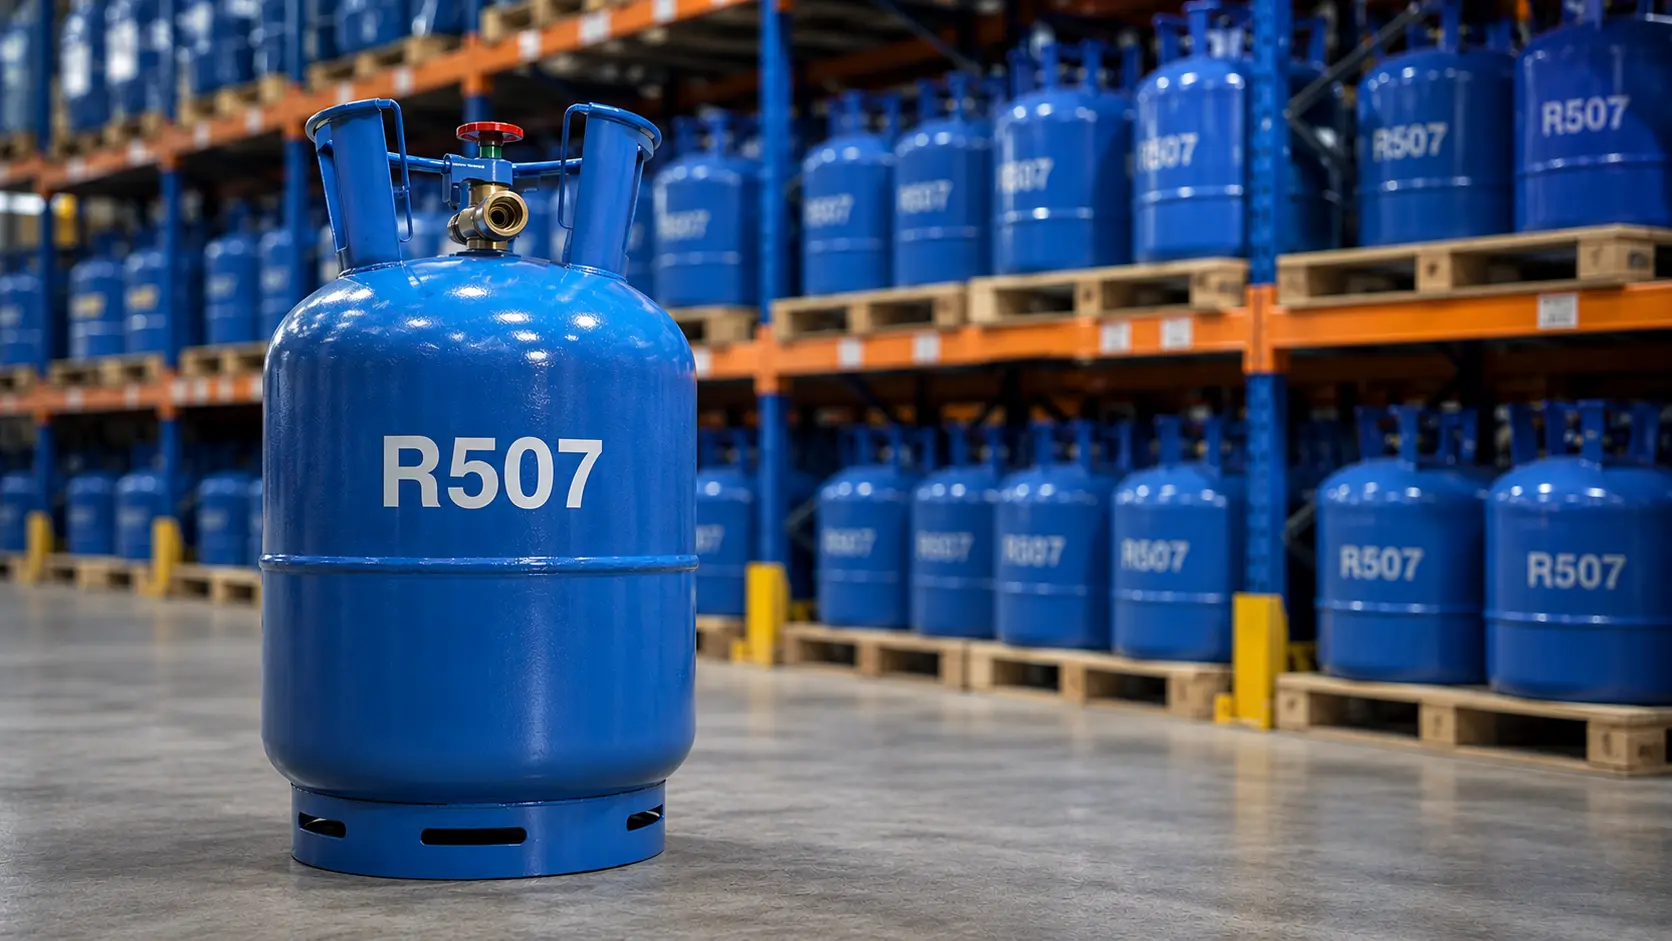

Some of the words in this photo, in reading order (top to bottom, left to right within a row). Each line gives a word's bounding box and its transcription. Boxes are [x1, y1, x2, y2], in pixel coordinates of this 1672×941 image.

[1542, 95, 1630, 137] R507
[1372, 121, 1448, 162] R507
[383, 435, 603, 509] R507
[1339, 545, 1424, 581] R507
[1527, 552, 1626, 590] R507
